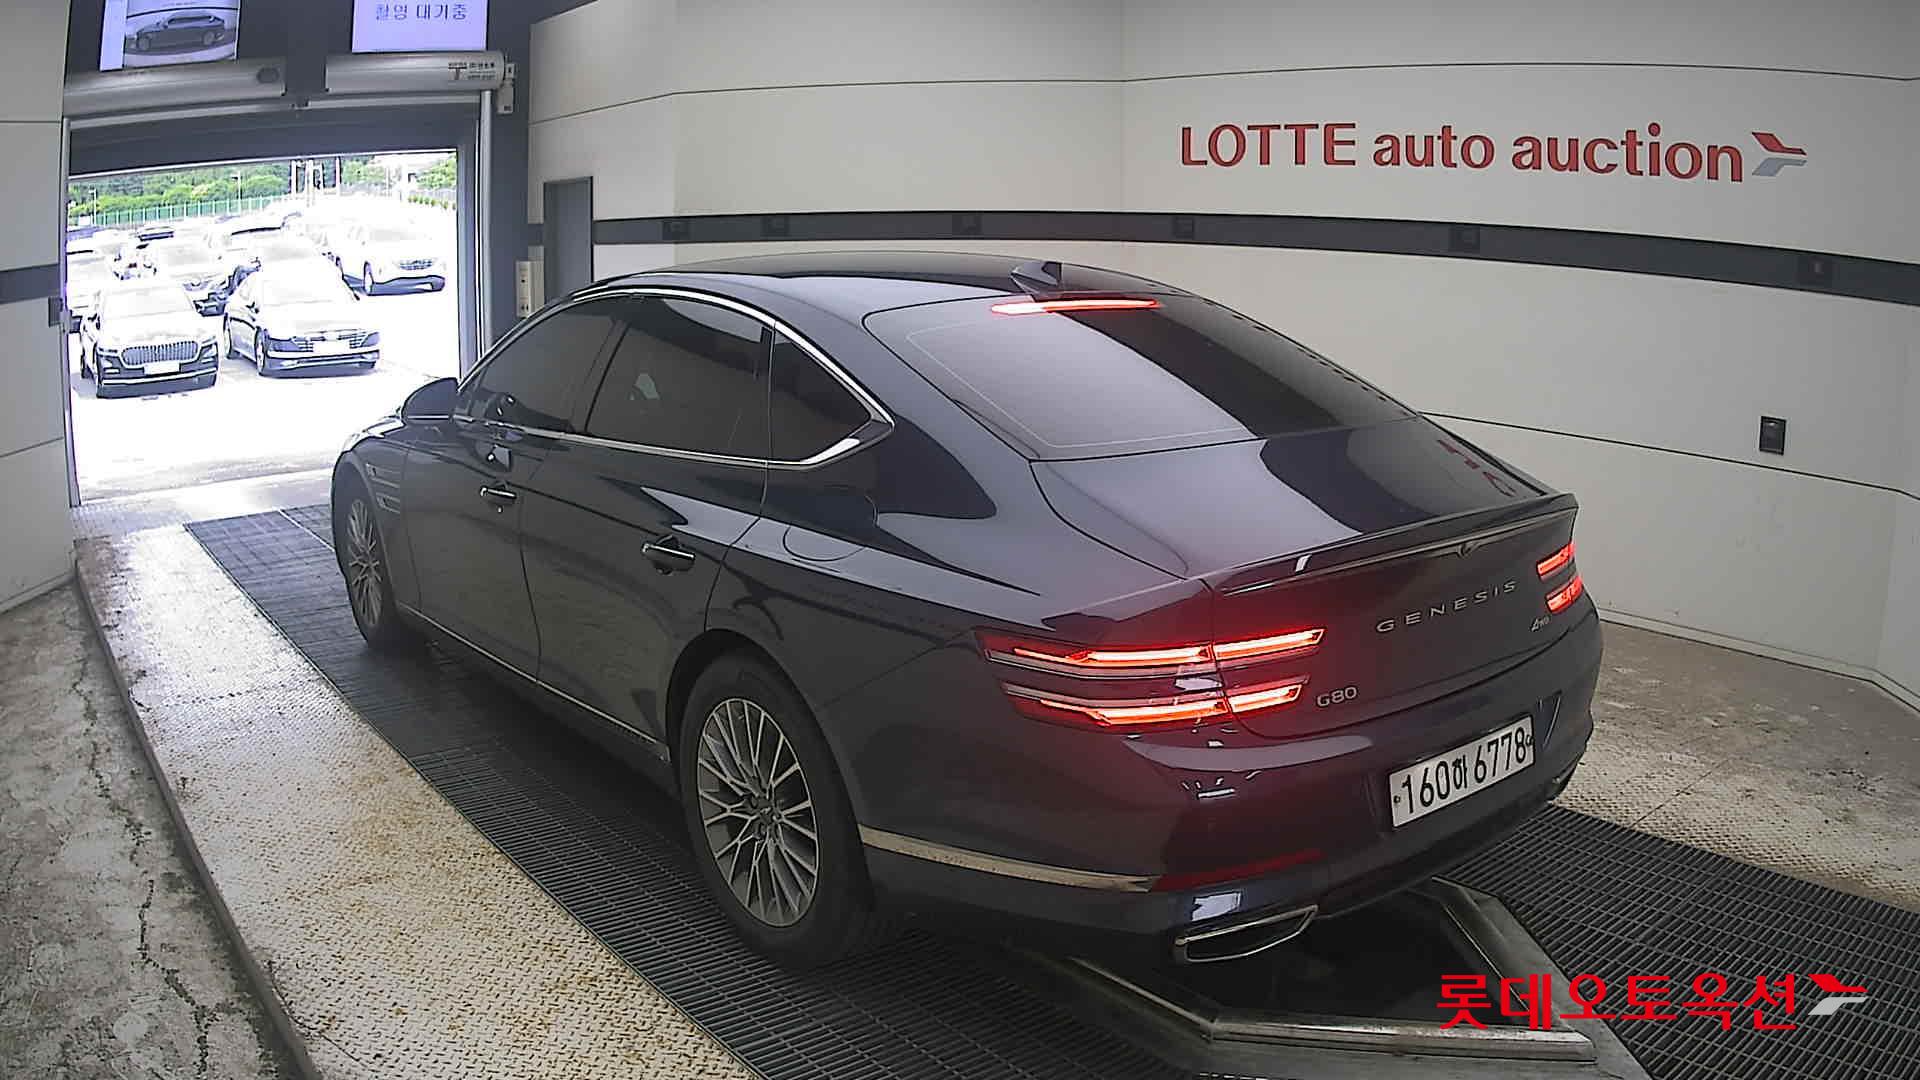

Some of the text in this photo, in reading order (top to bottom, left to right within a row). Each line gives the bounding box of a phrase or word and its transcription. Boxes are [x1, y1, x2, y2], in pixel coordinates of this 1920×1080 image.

[416, 3, 467, 20] 대기중
[1180, 122, 1743, 183] LOTTE auto auction
[1376, 580, 1517, 633] GENESIS
[1316, 686, 1358, 707] G80
[1474, 727, 1527, 784] 6778
